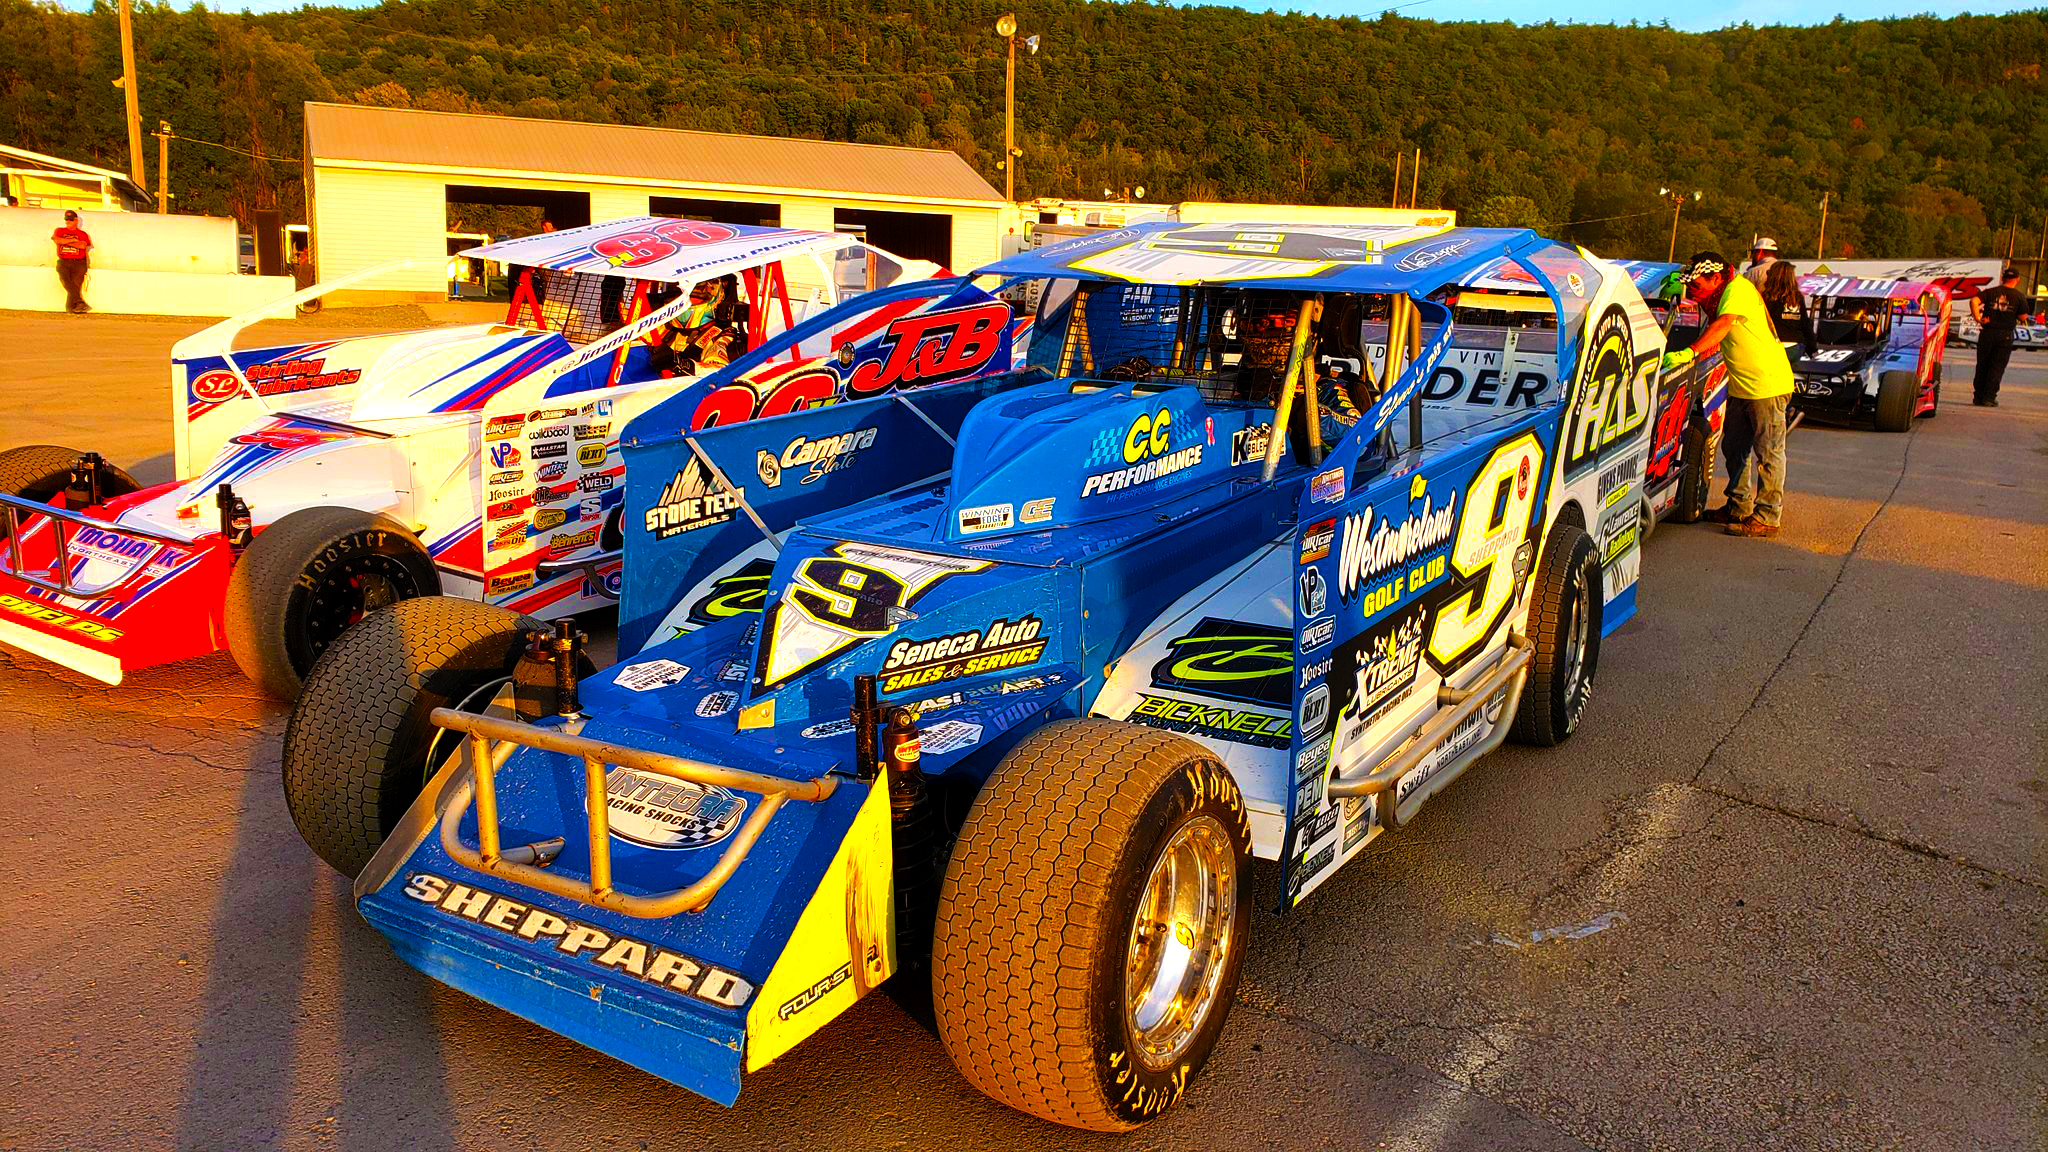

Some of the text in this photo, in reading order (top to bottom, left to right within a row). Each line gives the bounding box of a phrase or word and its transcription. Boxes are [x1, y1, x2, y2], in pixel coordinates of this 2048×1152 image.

[574, 300, 686, 367] Jimmy Phelps
[851, 303, 1012, 396] J&B
[200, 376, 234, 394] SL
[242, 368, 362, 400] Lubricants
[245, 357, 326, 382] Stirling
[581, 402, 595, 414] WIX
[529, 425, 570, 440] wilwood
[538, 443, 566, 452] ALLSTAR
[780, 427, 878, 469] Camara
[490, 442, 512, 468] VP
[800, 452, 858, 485] Slate
[1081, 443, 1204, 499] PERFORMANCE
[489, 487, 524, 502] Hoosier
[585, 477, 612, 489] WELD
[662, 514, 730, 538] MATERIALS
[961, 505, 1011, 519] WINNING
[981, 513, 1002, 524] EDGE
[74, 526, 191, 568] MOHAK
[1338, 489, 1456, 598] Westmoreland
[1429, 432, 1545, 666] 9
[1469, 526, 1520, 569] SHEPPARD
[142, 565, 162, 577] NC.
[491, 572, 531, 587] Beyea
[1363, 555, 1446, 618] GOLF CLUB
[497, 583, 527, 593] HEADERS
[884, 615, 1040, 670] Seneca Auto
[884, 646, 1044, 694] SALES & SERVICE
[1300, 656, 1333, 688] Hoosier
[1345, 635, 1423, 720] XTREME
[1366, 668, 1413, 707] LUBRICANTS
[1134, 695, 1292, 739] BICKNELL
[1302, 694, 1327, 725] BERT
[1350, 709, 1382, 741] SYNTHETIC
[1381, 697, 1401, 717] RACING
[920, 721, 960, 747] ONOVAN'S
[1298, 738, 1331, 768] Beyea
[606, 768, 745, 825] INTEGRA
[1295, 774, 1324, 817] PEM
[1400, 764, 1431, 796] Swift
[607, 797, 700, 830] ACING SHOCKS
[402, 872, 756, 1009] SHEPPARD
[778, 974, 832, 1021] FOUR
